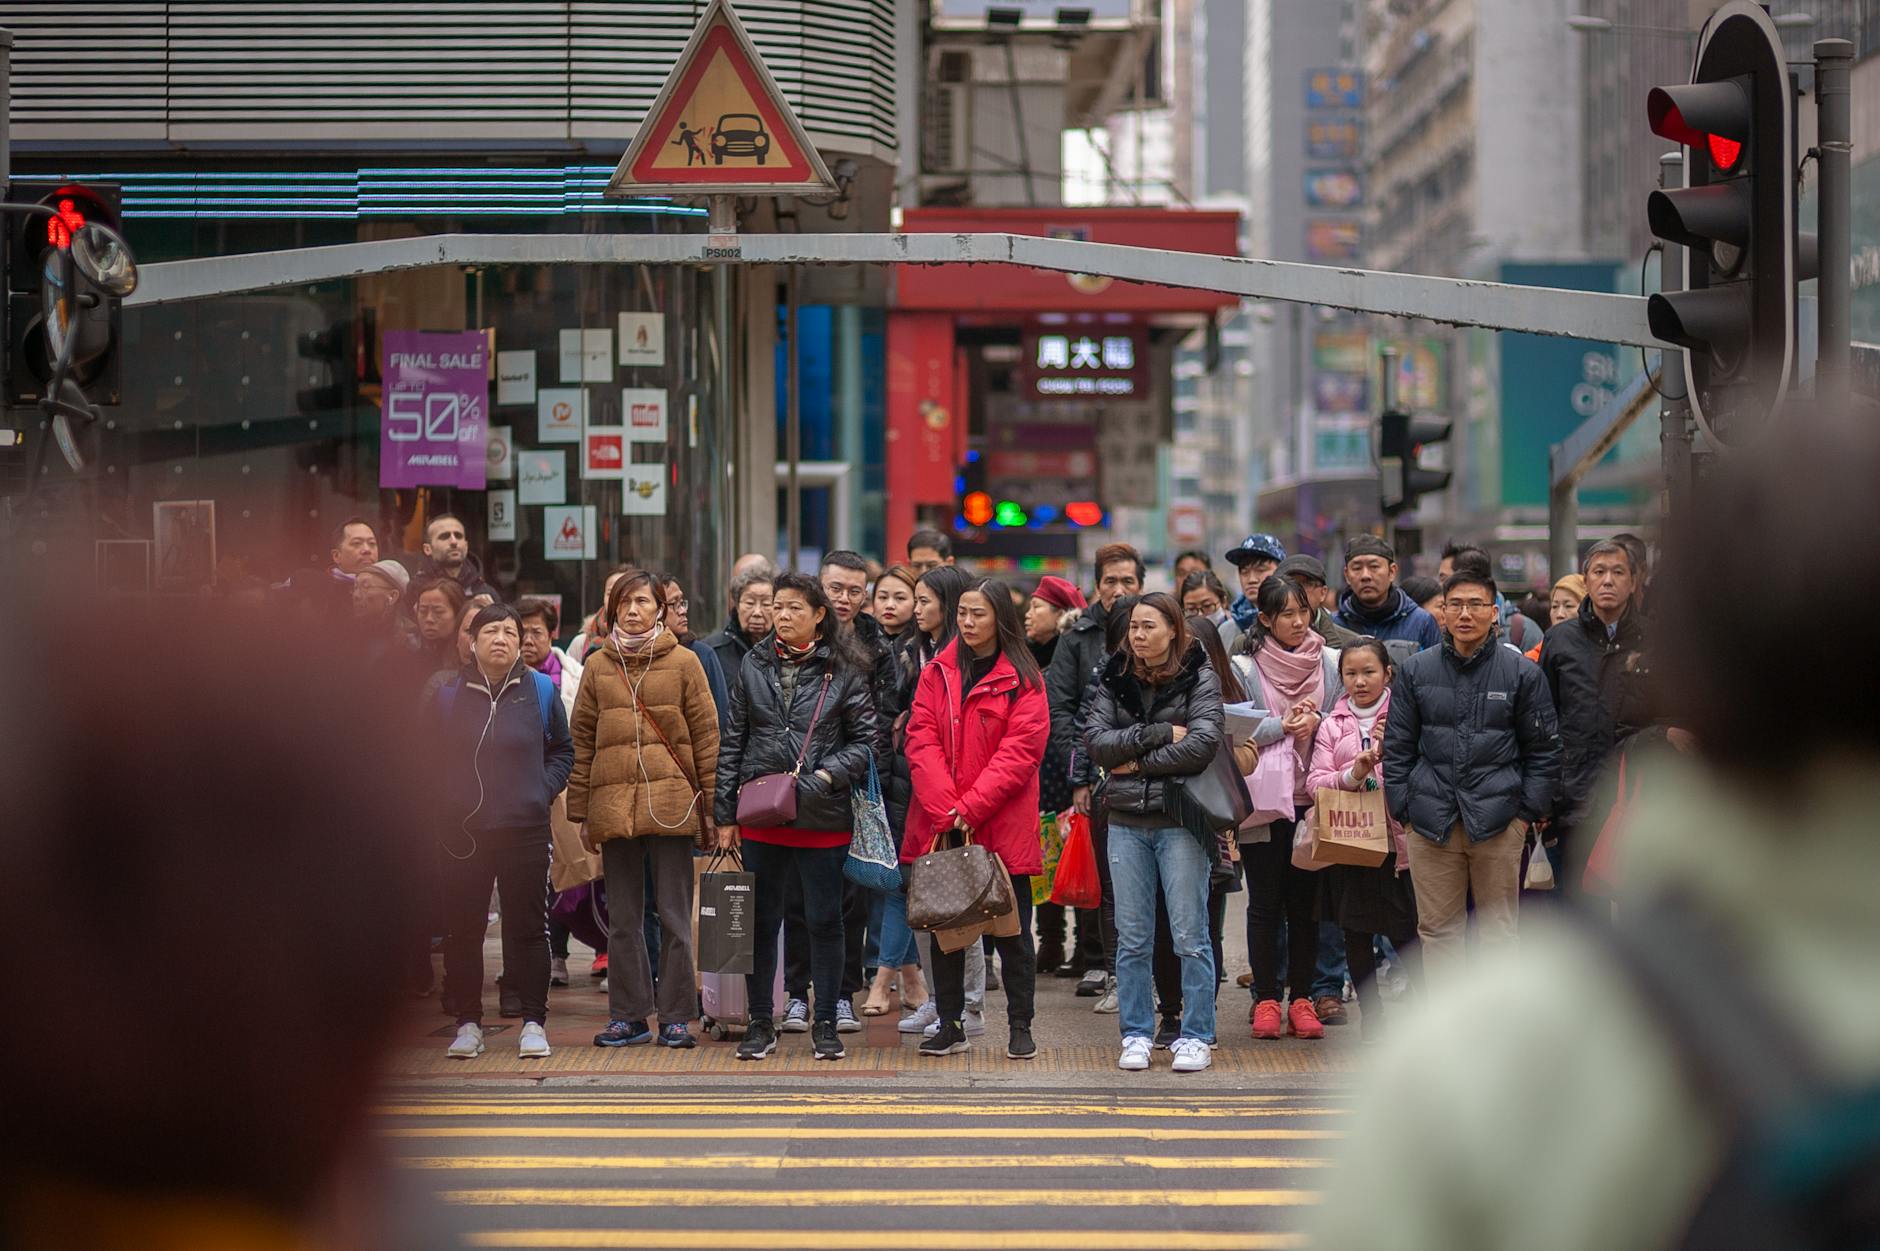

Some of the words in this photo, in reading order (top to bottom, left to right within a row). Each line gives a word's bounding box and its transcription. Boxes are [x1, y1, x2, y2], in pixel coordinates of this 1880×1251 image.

[706, 248, 741, 258] PS002
[390, 353, 437, 368] FINAL
[439, 353, 481, 369] SALE
[1329, 809, 1374, 828] MUJI
